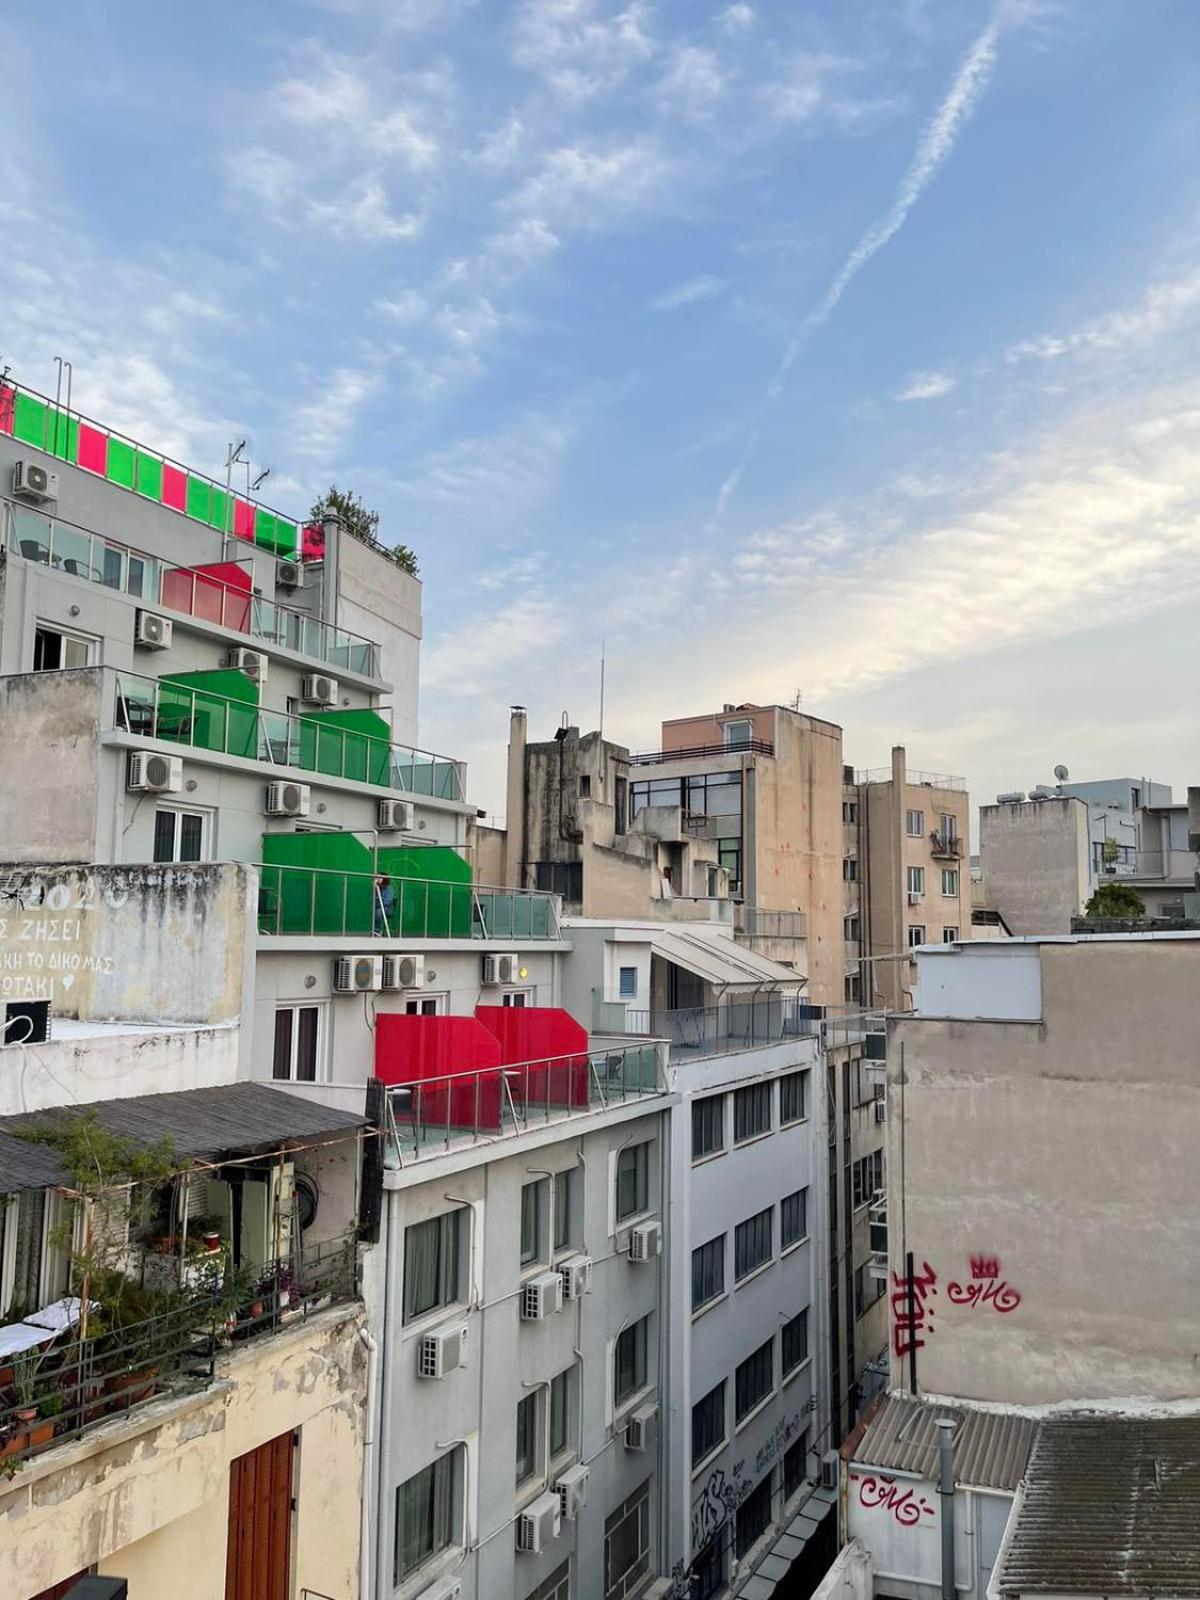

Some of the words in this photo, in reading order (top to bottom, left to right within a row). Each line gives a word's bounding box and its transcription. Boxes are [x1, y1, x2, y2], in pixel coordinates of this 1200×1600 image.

[19, 919, 81, 940] ΖΗΣΕΙ
[27, 952, 44, 968] ΤΟ
[49, 952, 81, 970] ΔΙΚΟ
[82, 955, 115, 975] ΜΑΣ
